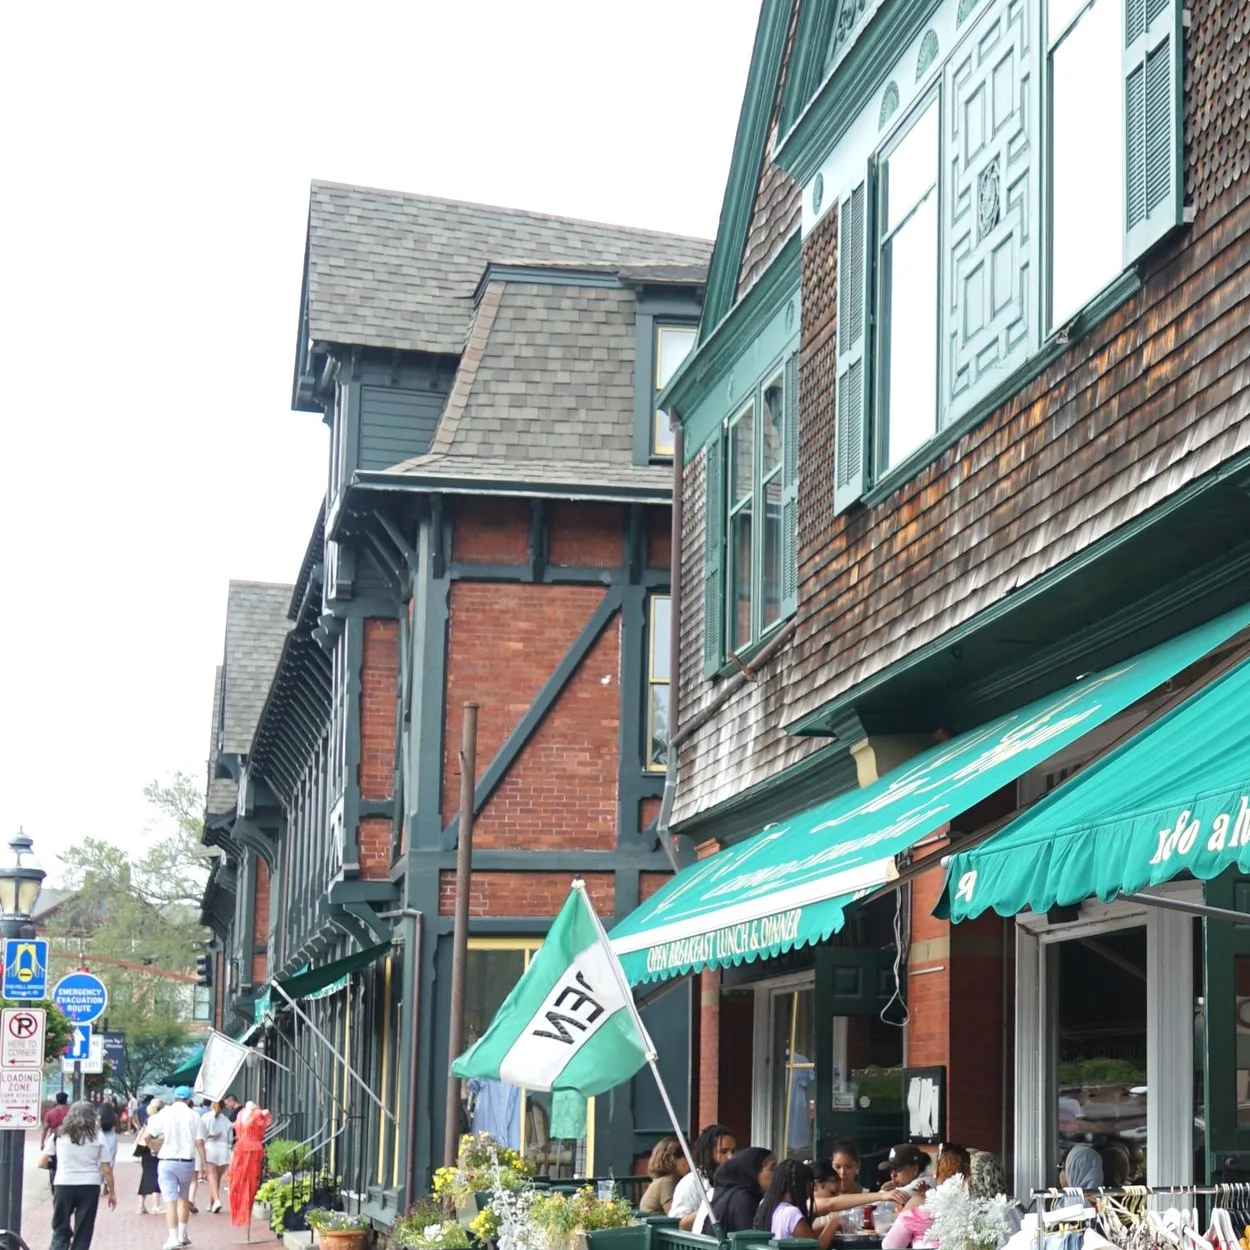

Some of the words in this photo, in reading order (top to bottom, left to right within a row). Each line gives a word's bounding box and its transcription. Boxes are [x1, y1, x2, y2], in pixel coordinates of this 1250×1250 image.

[1207, 813, 1230, 851] a
[647, 947, 670, 972] OPEN
[668, 932, 716, 968] BREAKFAST
[716, 923, 749, 958] LUNCH
[751, 922, 760, 950] &
[761, 907, 802, 946] DINNER
[59, 988, 102, 996] EMERGENCY
[8, 1049, 36, 1057] CORNER
[2, 1074, 38, 1082] LOADING
[8, 1083, 31, 1092] ZONE
